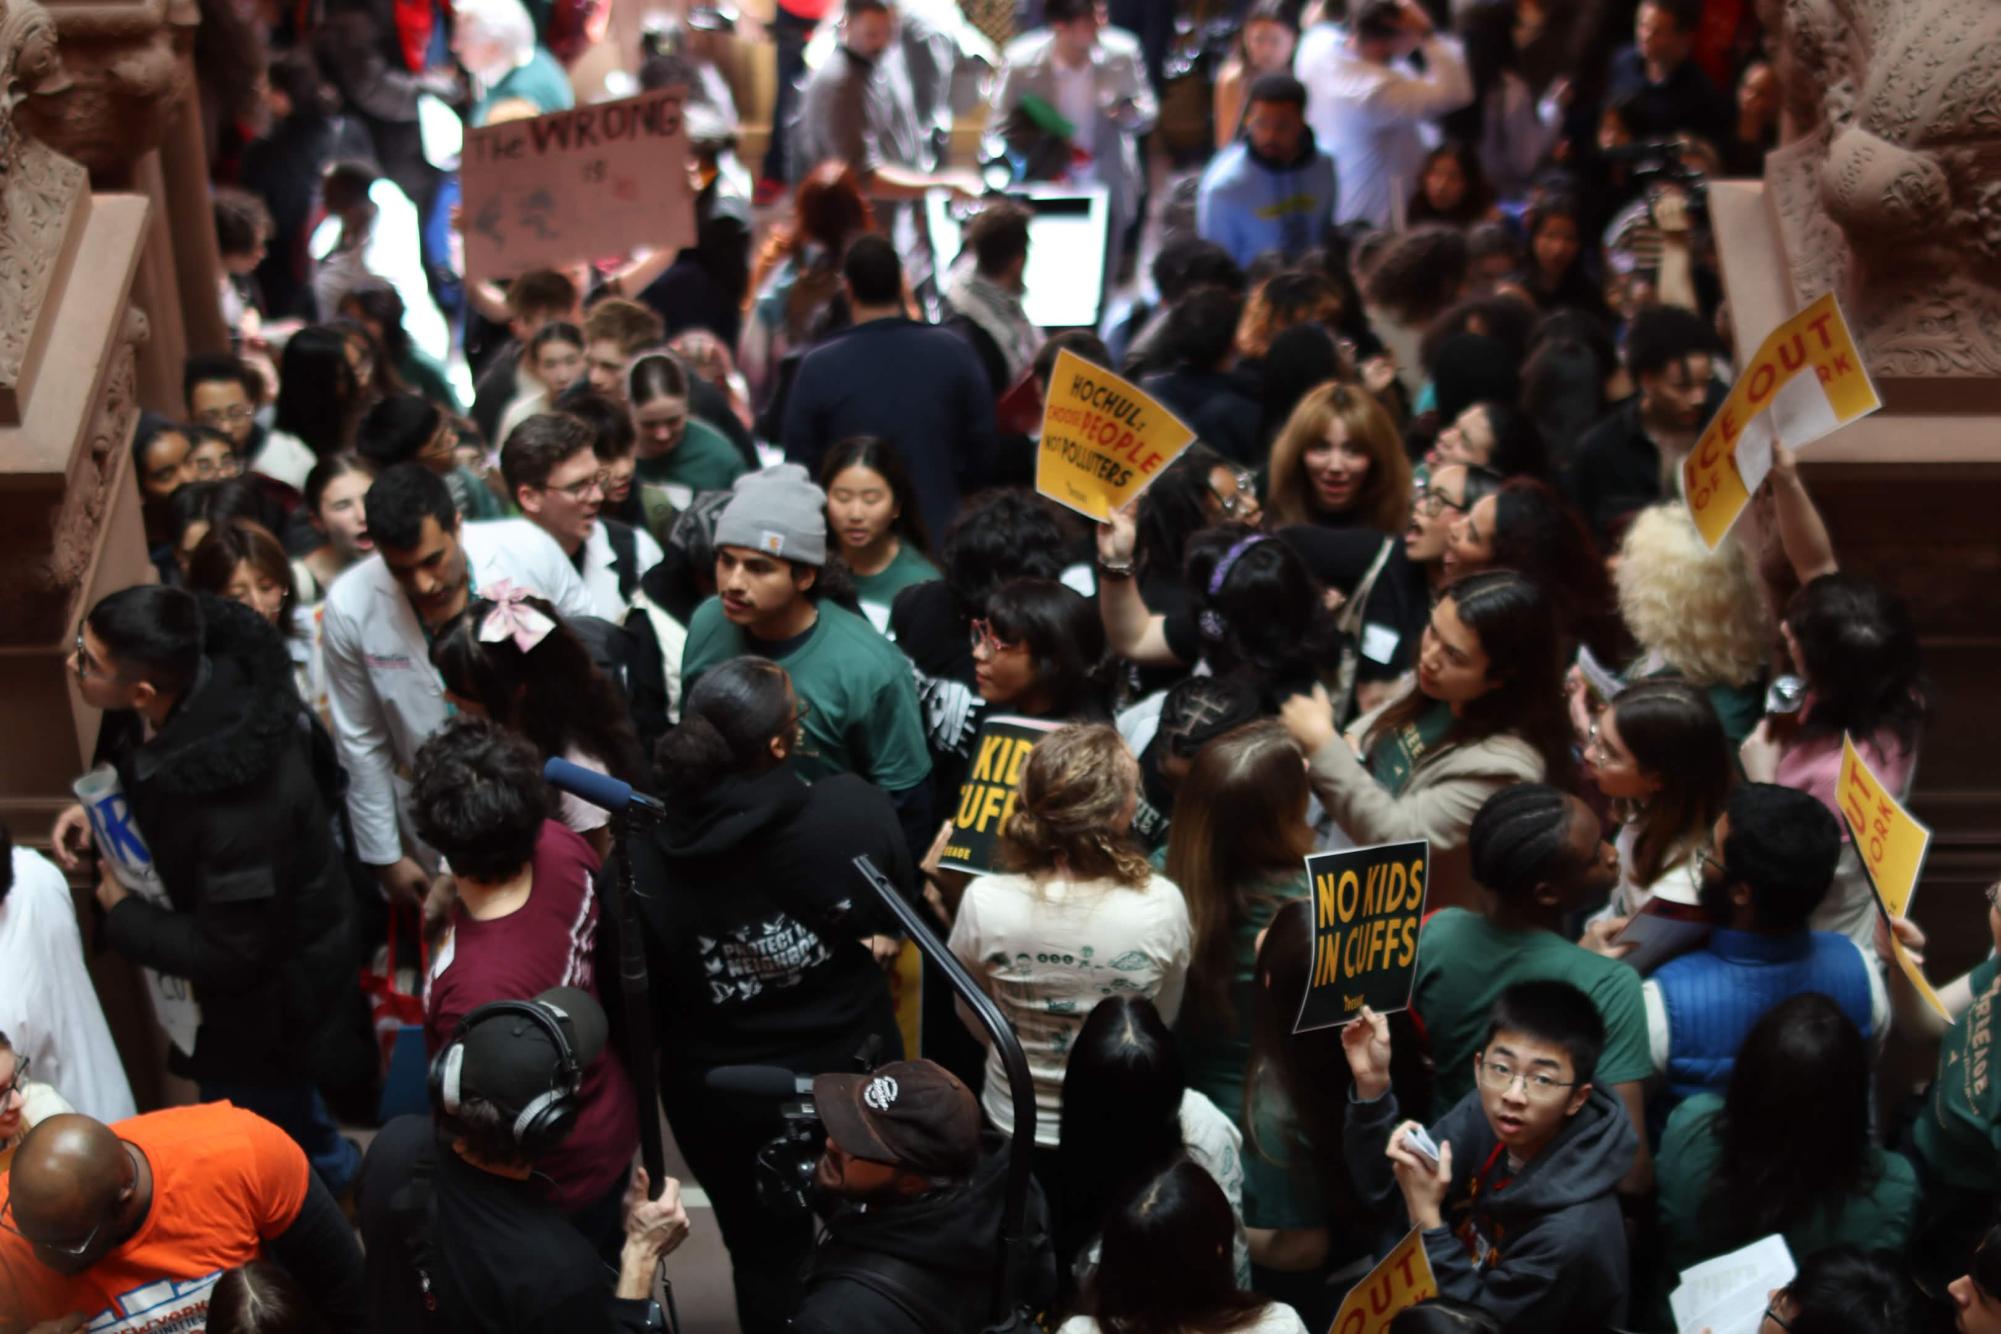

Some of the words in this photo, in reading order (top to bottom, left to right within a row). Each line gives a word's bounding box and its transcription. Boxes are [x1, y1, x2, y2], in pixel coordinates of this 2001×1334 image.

[530, 97, 682, 154] WRONG
[1688, 407, 1737, 490] ICE
[1747, 311, 1833, 405] OUT
[1060, 437, 1133, 488] POLLUTERS
[1080, 410, 1164, 475] PEOPLE
[1316, 869, 1359, 929] NO
[1361, 859, 1424, 918] KIDS
[1313, 932, 1341, 988] IN
[1343, 916, 1418, 979] CUFFS
[1340, 1247, 1417, 1334] OUT
